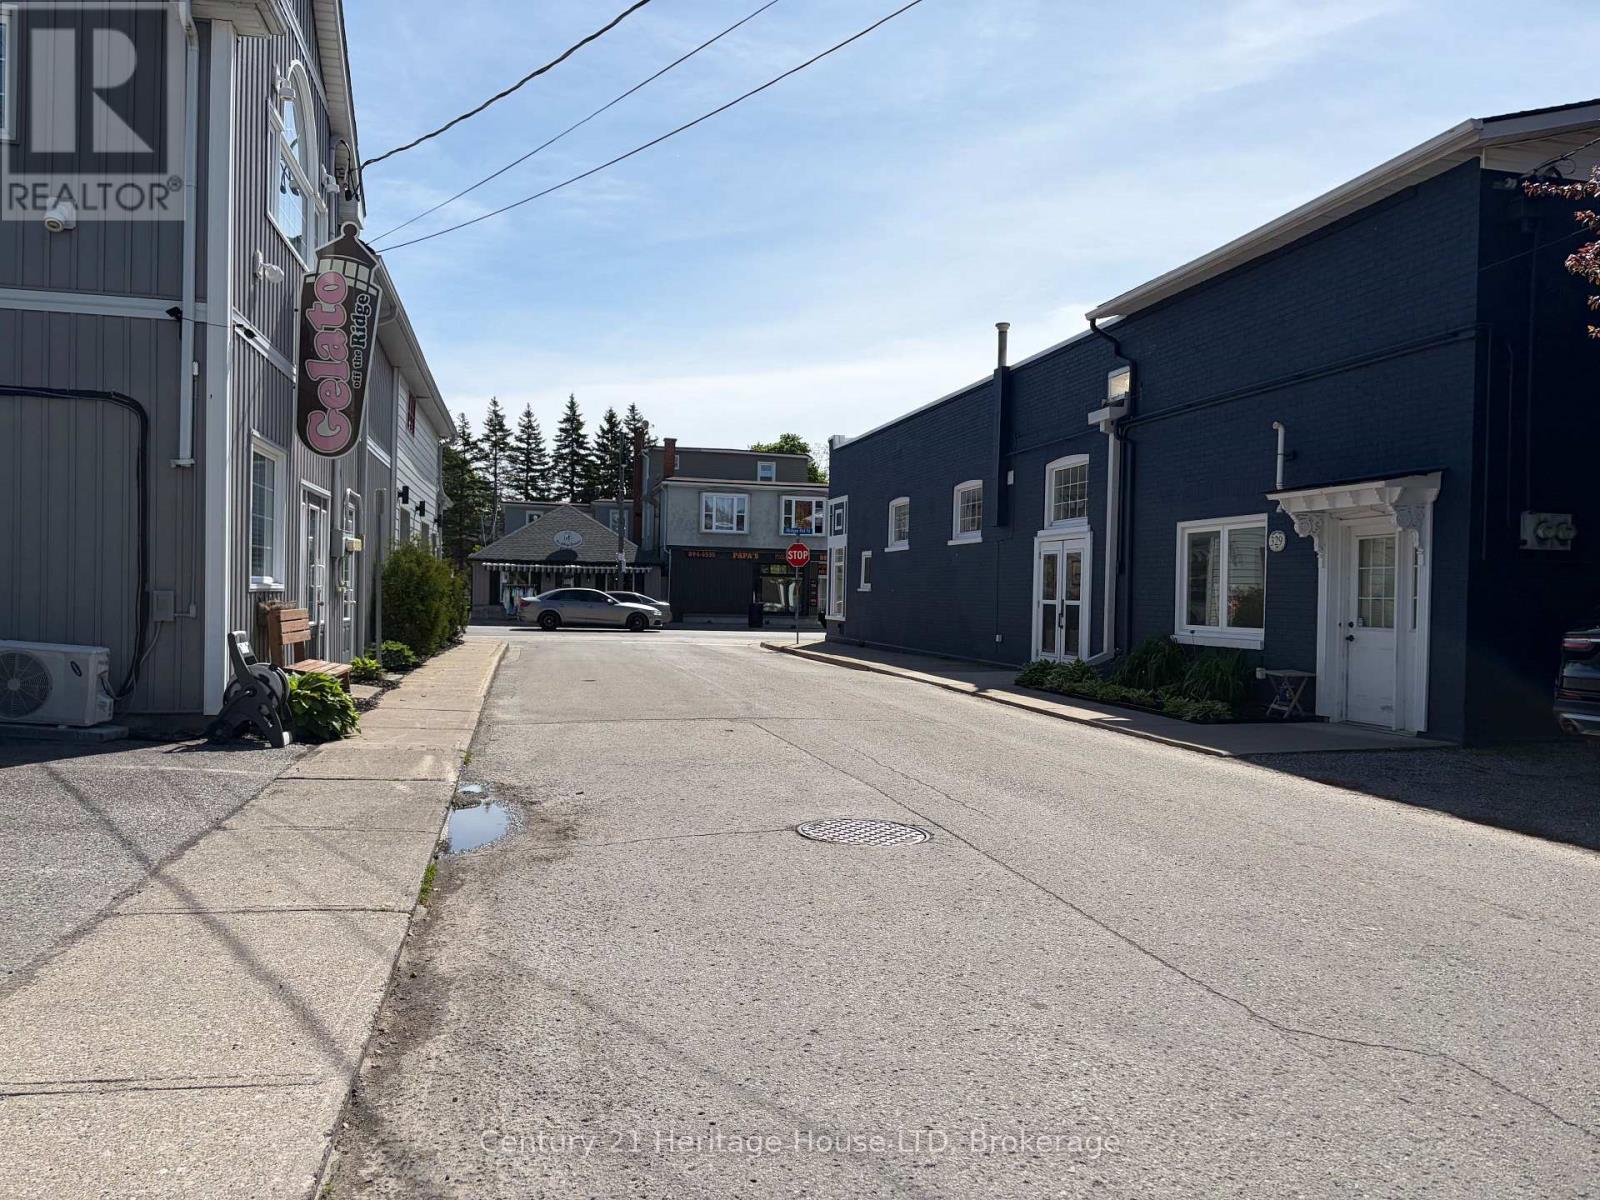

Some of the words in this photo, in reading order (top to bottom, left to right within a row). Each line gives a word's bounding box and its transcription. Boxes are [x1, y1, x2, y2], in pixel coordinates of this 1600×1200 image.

[350, 293, 370, 349] Ridge
[306, 270, 352, 452] Gelato
[354, 350, 364, 368] the
[352, 371, 362, 389] off
[787, 550, 808, 560] STOP
